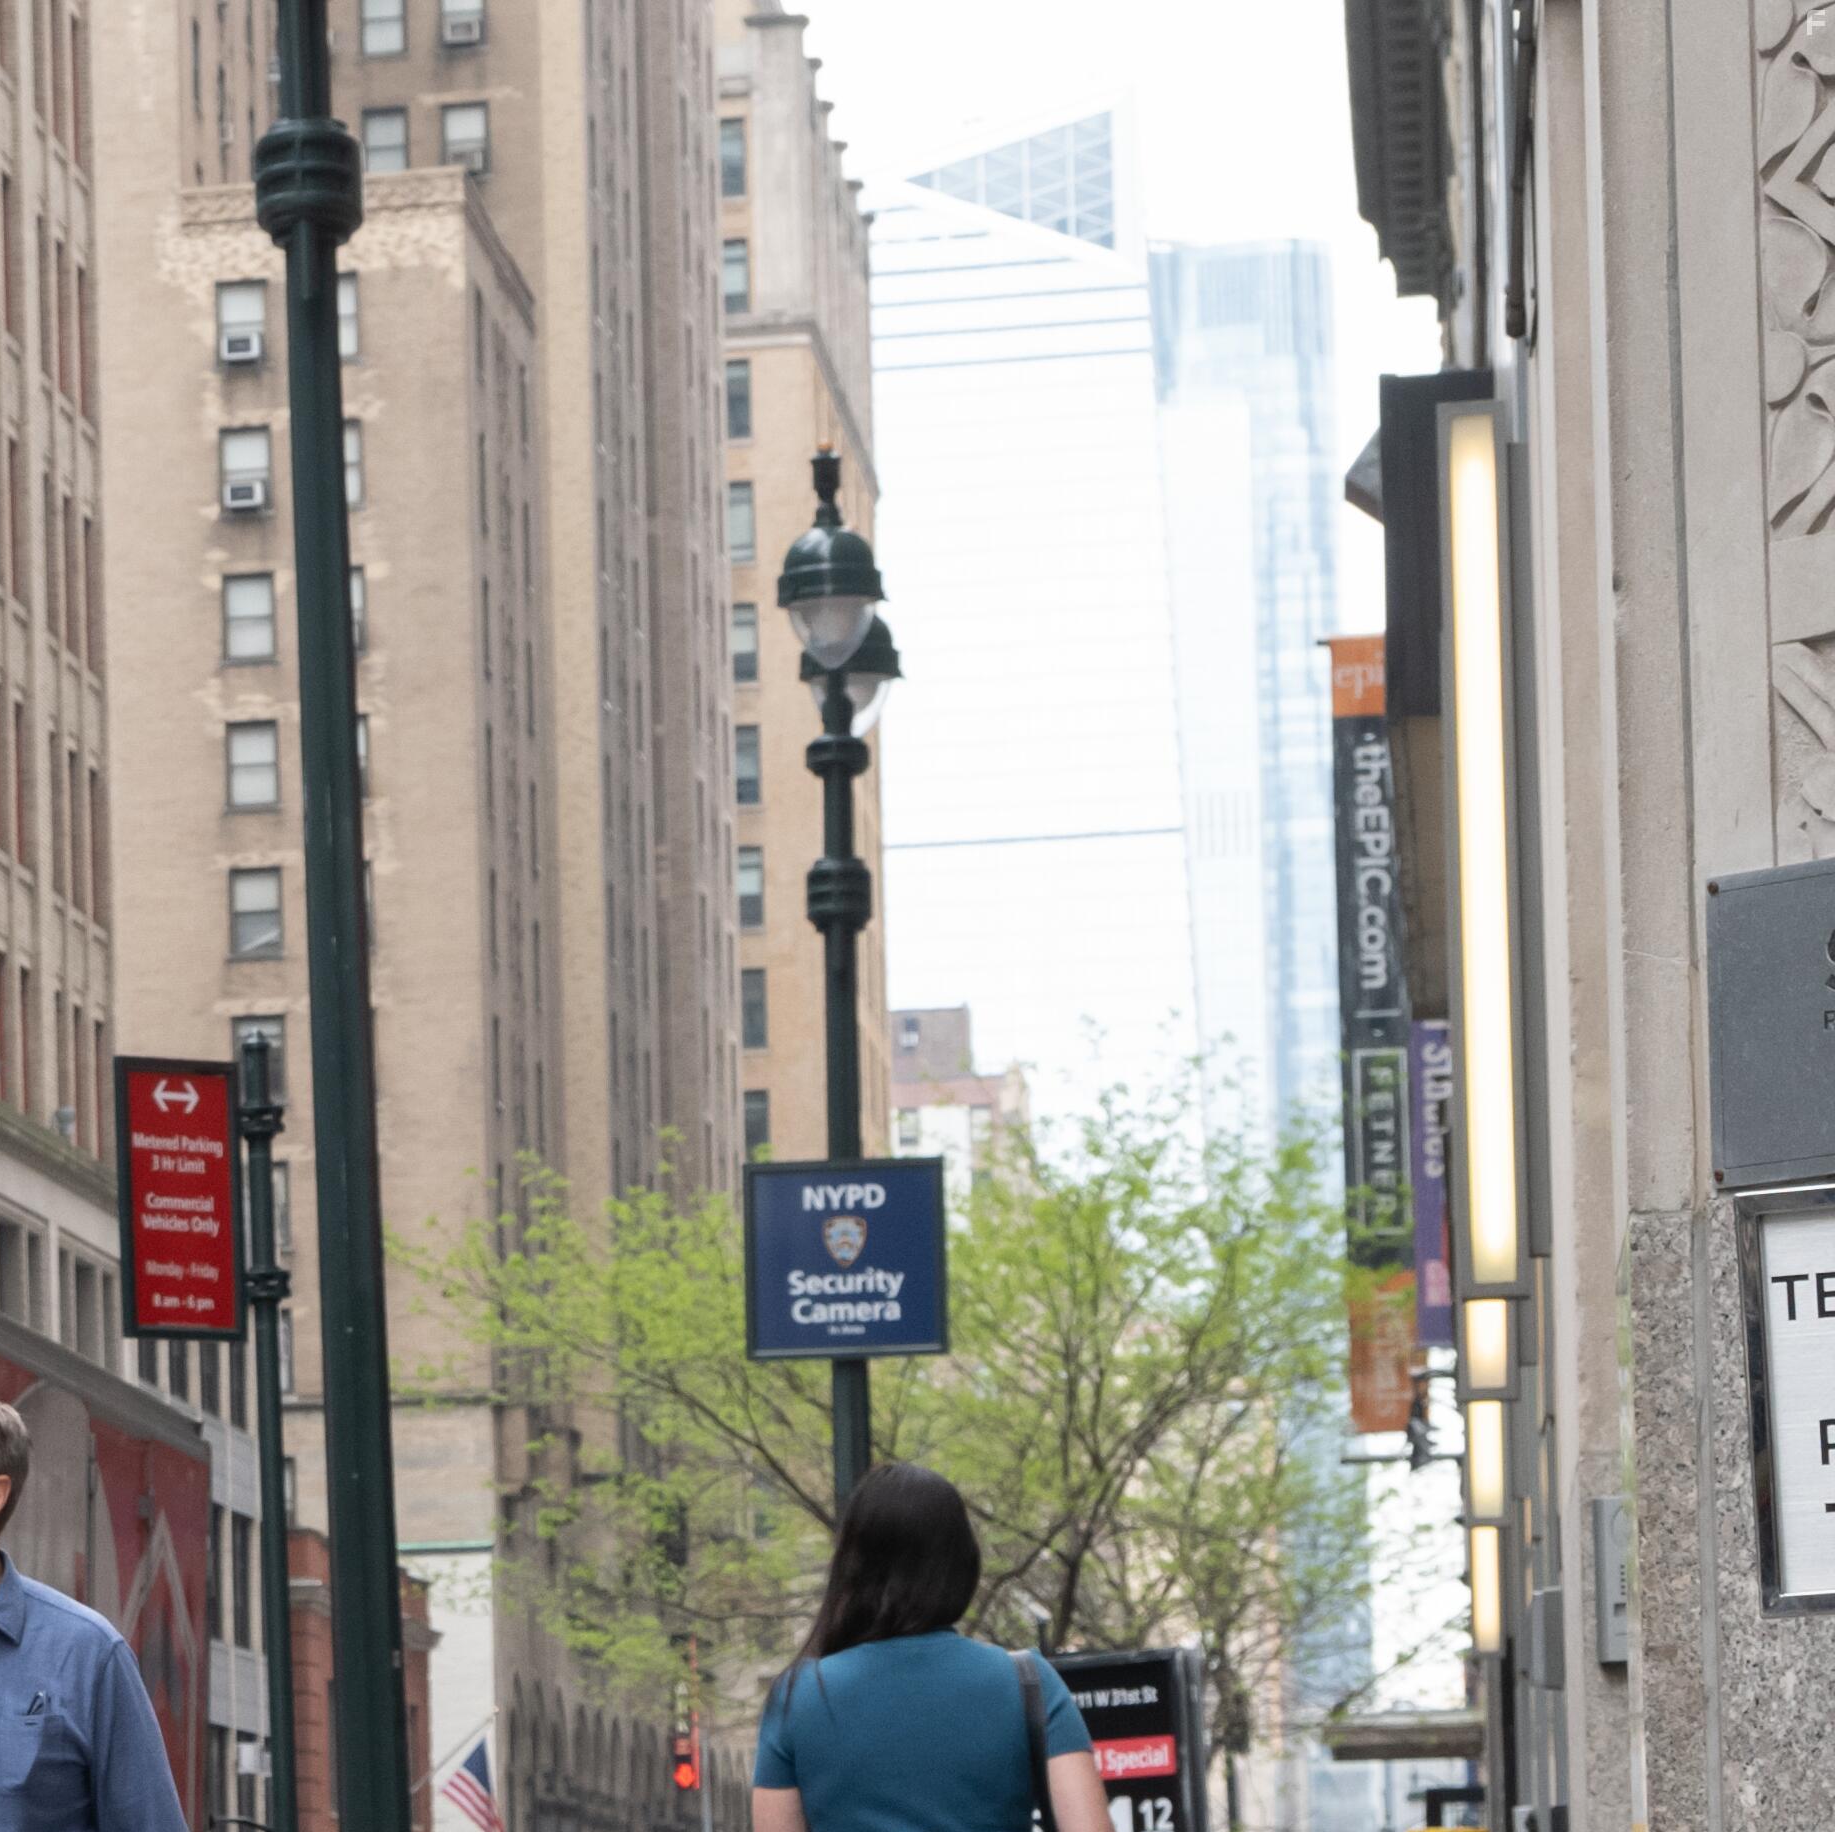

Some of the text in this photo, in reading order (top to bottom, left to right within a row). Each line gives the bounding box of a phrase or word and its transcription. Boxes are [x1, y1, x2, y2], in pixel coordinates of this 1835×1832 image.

[1353, 743, 1393, 989] theEPIC.com
[132, 1132, 223, 1158] Metered Parking
[161, 1154, 175, 1171] Hr
[177, 1157, 206, 1174] Limit
[144, 1192, 215, 1212] Commercial
[801, 1183, 887, 1211] NYPD
[141, 1213, 220, 1238] Vehicles Only
[787, 1266, 905, 1298] Security
[791, 1297, 902, 1324] Camera
[1094, 1689, 1110, 1708] W
[1105, 1743, 1169, 1776] Special
[1138, 1796, 1175, 1832] 12
